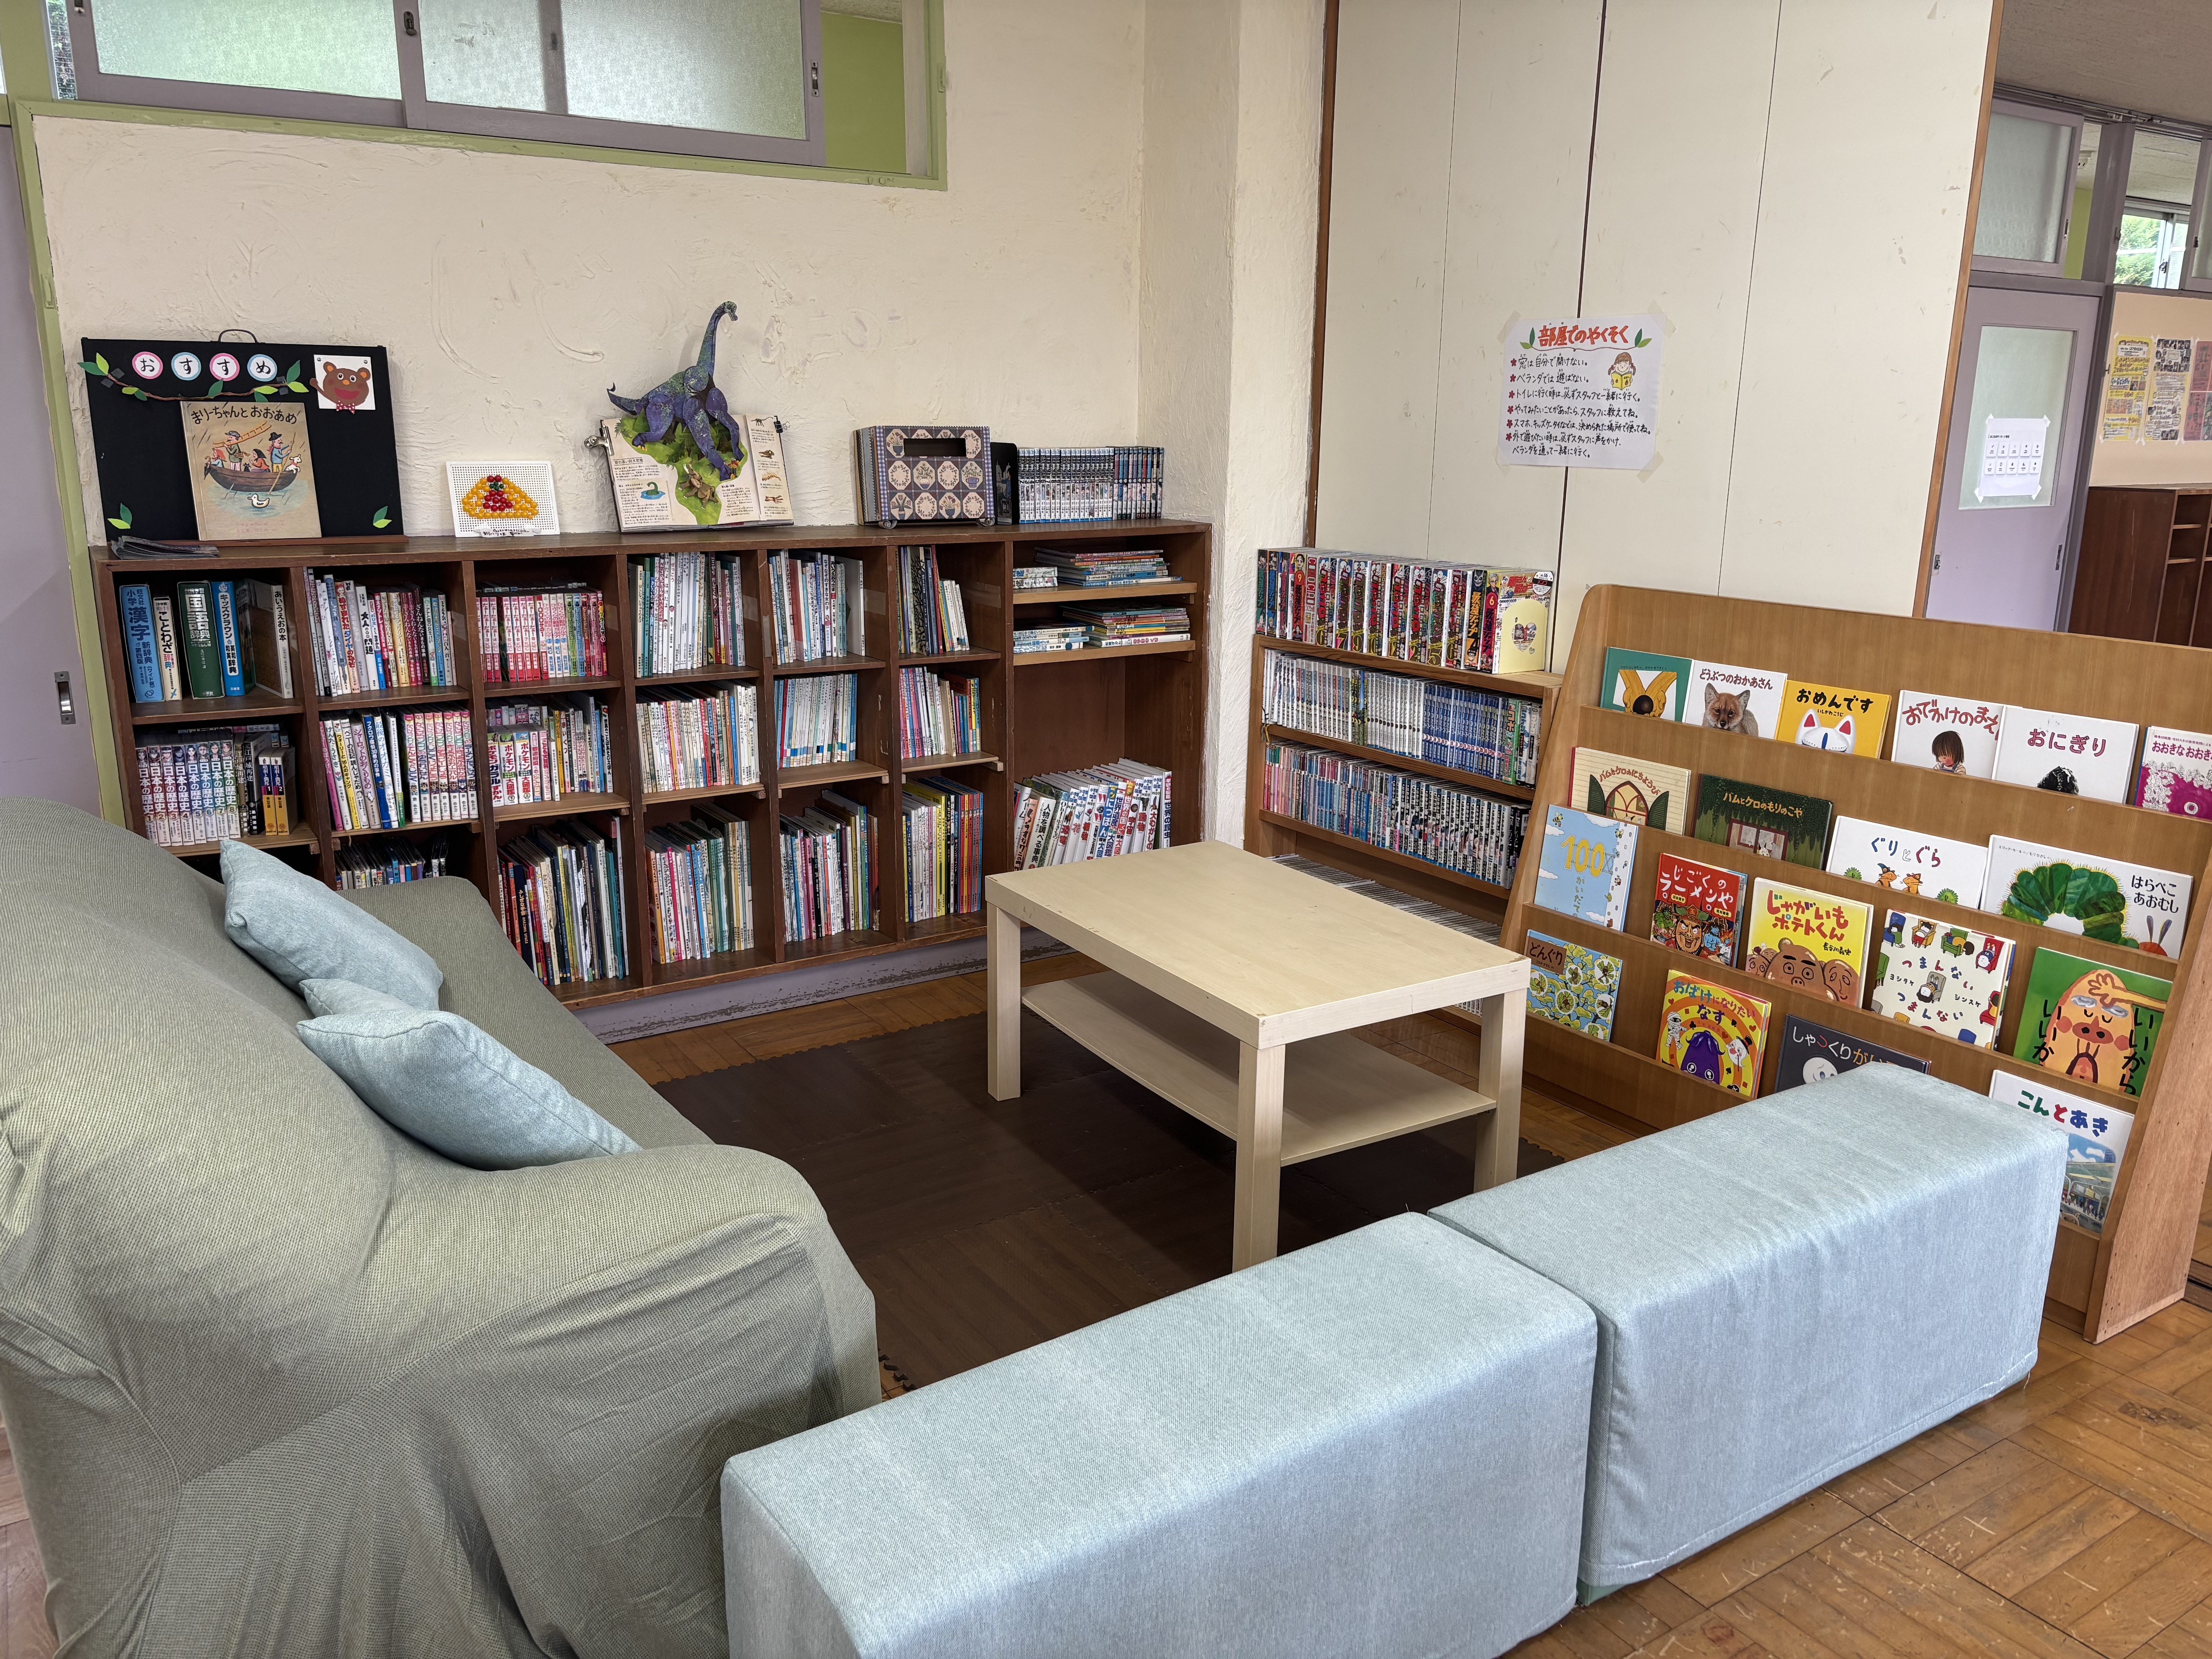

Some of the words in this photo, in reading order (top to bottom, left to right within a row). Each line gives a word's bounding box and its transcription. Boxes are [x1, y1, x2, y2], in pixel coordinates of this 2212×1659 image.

[1538, 325, 1629, 347] 部屋でのやくそく
[140, 358, 271, 375] おすすめ
[127, 589, 137, 605] 小学
[137, 589, 145, 605] 旺文社
[1489, 596, 1494, 605] 6
[128, 607, 151, 641] 漢字
[159, 611, 172, 653] ことわざ
[220, 594, 232, 639] キッズクラウン
[275, 591, 287, 642] あいうえおの本
[1427, 648, 1441, 666] 5
[1699, 668, 1773, 690] どうぶつのおかあさん
[1796, 688, 1874, 713] おめんです
[1902, 698, 1999, 741] おでかけのまえ
[505, 744, 515, 772] ポケモン
[521, 743, 531, 770] ポケモン
[2027, 728, 2107, 757] おにぎり
[2152, 740, 2185, 757] おおきな
[2186, 746, 2212, 761] おおき
[354, 728, 372, 789] シャーロットのおくりもの
[139, 768, 154, 814] 日本の歴史
[151, 766, 166, 812] 日本の歴史
[164, 765, 178, 812] 日本の歴史
[176, 765, 191, 812] 日本の歴史
[189, 764, 203, 809] 日本の歴史
[200, 762, 215, 808] 日本の歴史
[211, 761, 226, 807] 日本の歴史
[223, 759, 237, 805] 日本の歴史
[1599, 766, 1661, 796] バムとケロのにちようび
[1099, 798, 1115, 837] にっぽん
[1111, 796, 1123, 826] 世界遺産
[1723, 792, 1803, 818] バムとケロのもりのこや
[1032, 804, 1051, 863] 人物を調べる事典
[1072, 823, 1081, 833] 花
[1137, 812, 1147, 832] 動物
[1561, 835, 1606, 878] 100
[1871, 836, 1941, 867] ぐりとぐら
[1659, 871, 1734, 910] ラーメンや
[1674, 864, 1726, 889] じごくの
[2131, 874, 2178, 897] はらぺこ
[1766, 888, 1850, 930] じゃがいも
[2133, 891, 2179, 914] あおむし
[1771, 912, 1845, 943] ポテトくん
[1530, 942, 1563, 966] どんぐり
[1822, 941, 1852, 956] 長谷川義史
[1889, 973, 1915, 986] ヨシタケ
[1902, 956, 1974, 991] つまんない
[1673, 980, 1755, 1018] おばけになりたい
[1697, 1003, 1725, 1025] なす
[1897, 992, 1963, 1022] つまんない
[1954, 994, 1982, 1008] シンスケ
[1793, 1026, 1897, 1065] しゃっくりが
[2032, 999, 2062, 1066] いいか
[2119, 1006, 2154, 1096] いいから
[2017, 1089, 2108, 1137] こんとあき
